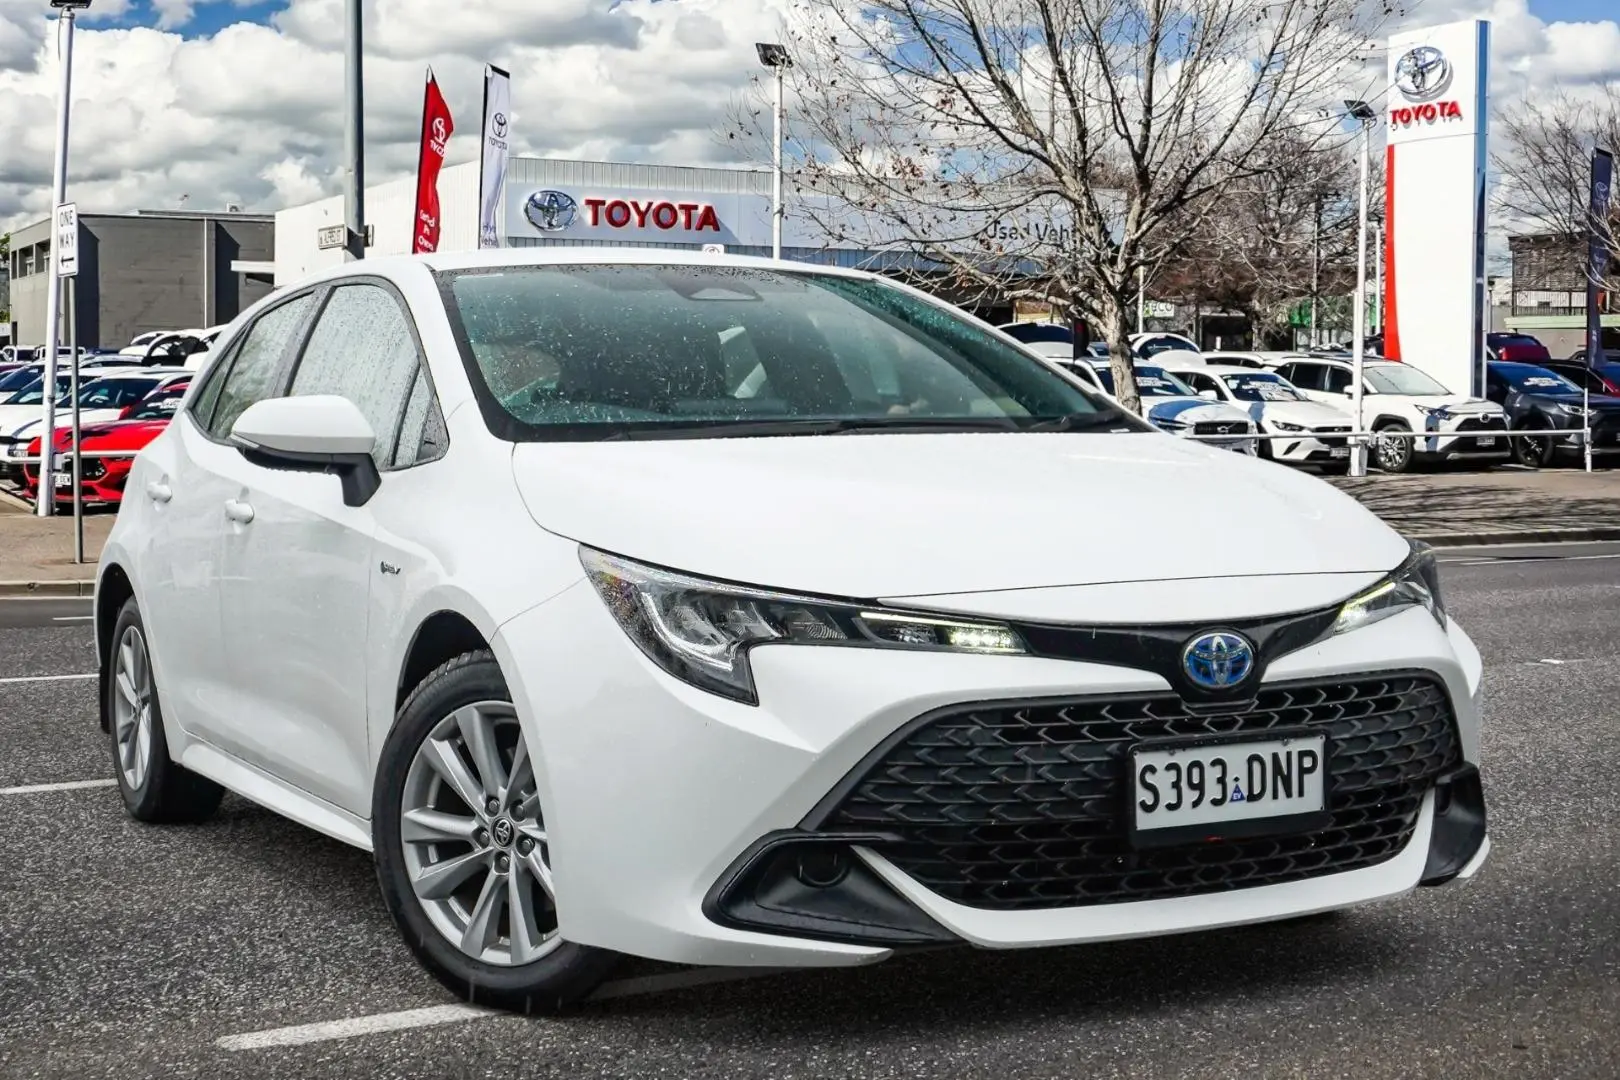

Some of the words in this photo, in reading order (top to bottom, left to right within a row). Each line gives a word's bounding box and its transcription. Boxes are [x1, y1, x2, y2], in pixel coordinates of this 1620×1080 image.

[1389, 100, 1463, 124] TOYOTA
[60, 210, 74, 227] ONE
[585, 199, 721, 232] TOYOTA
[60, 232, 75, 249] WAY
[986, 220, 1030, 240] Used
[1139, 757, 1229, 813] S393
[1246, 749, 1319, 803] DNP
